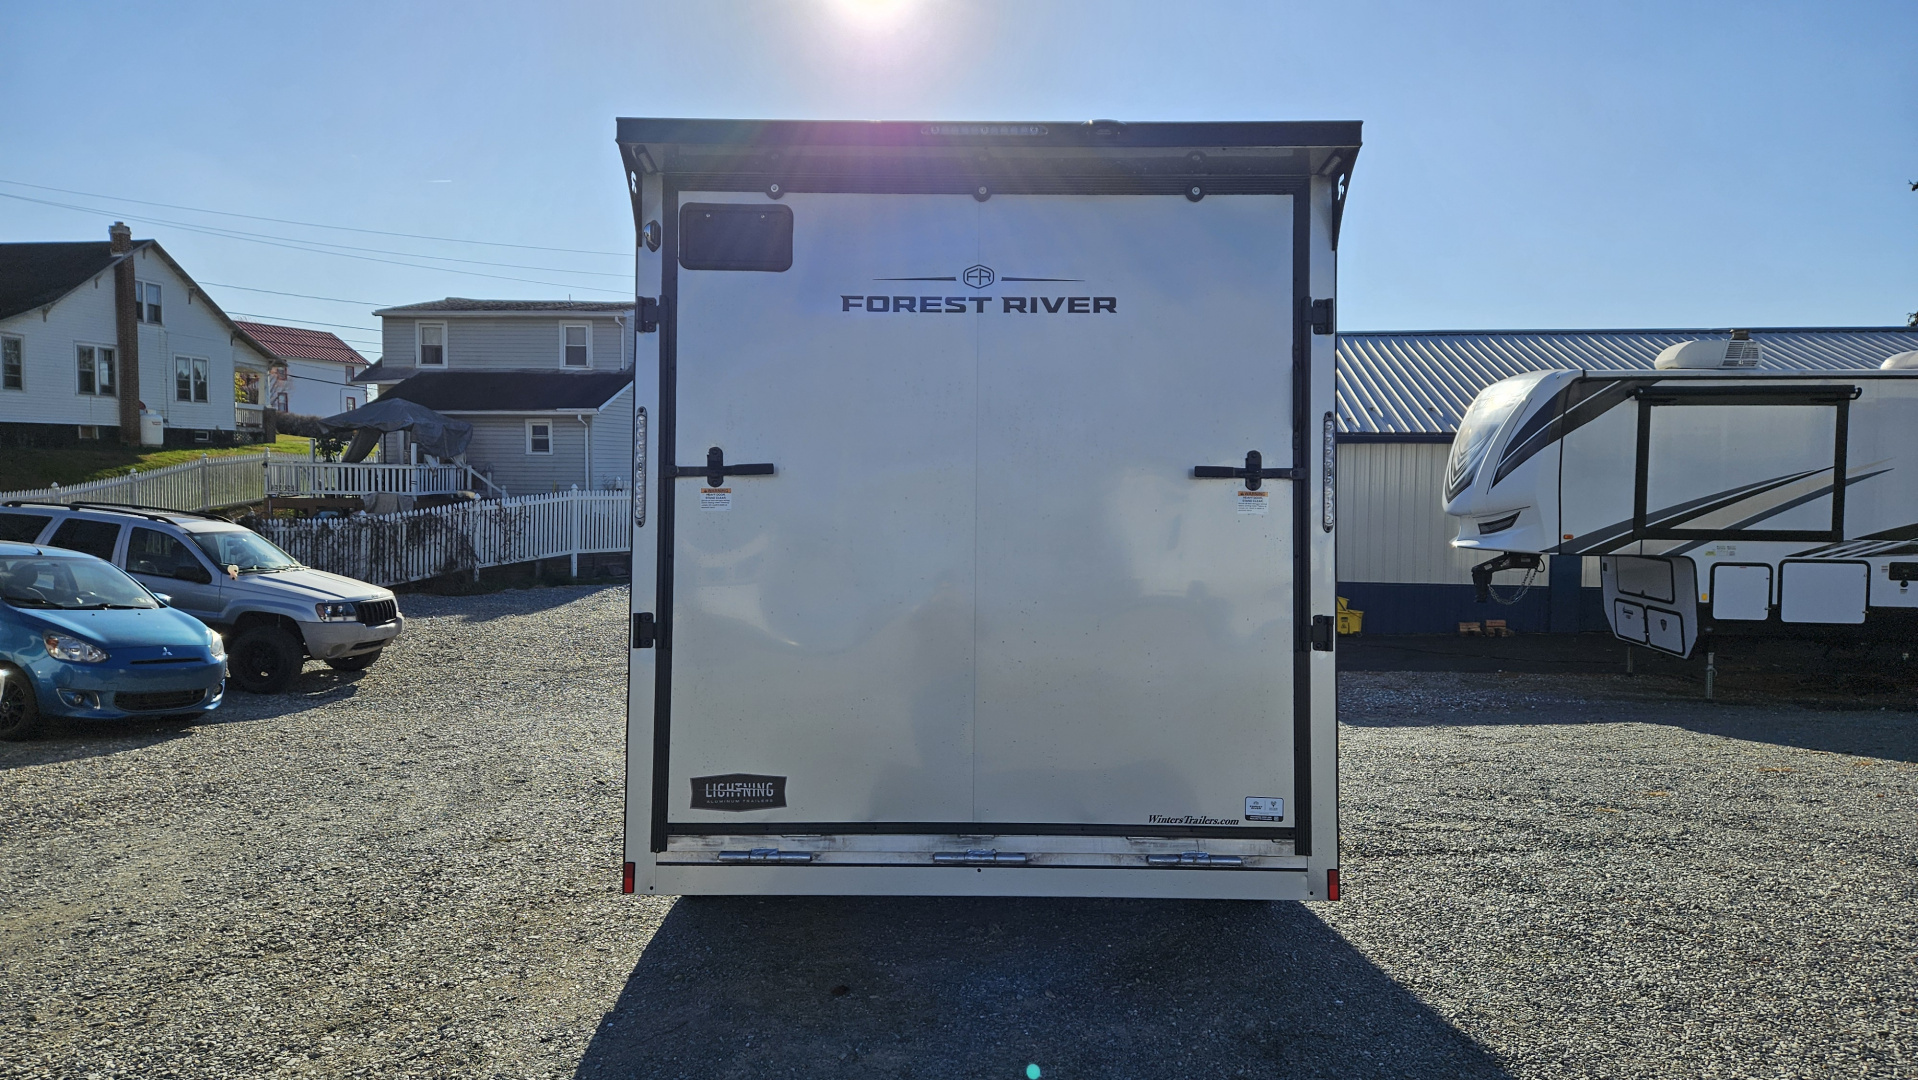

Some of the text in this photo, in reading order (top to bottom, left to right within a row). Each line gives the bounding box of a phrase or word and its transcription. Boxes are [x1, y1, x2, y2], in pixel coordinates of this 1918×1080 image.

[840, 295, 1118, 314] FOREST RIVER
[705, 782, 774, 798] LIGHTNING
[1148, 814, 1239, 825] WintersTrailers.com
